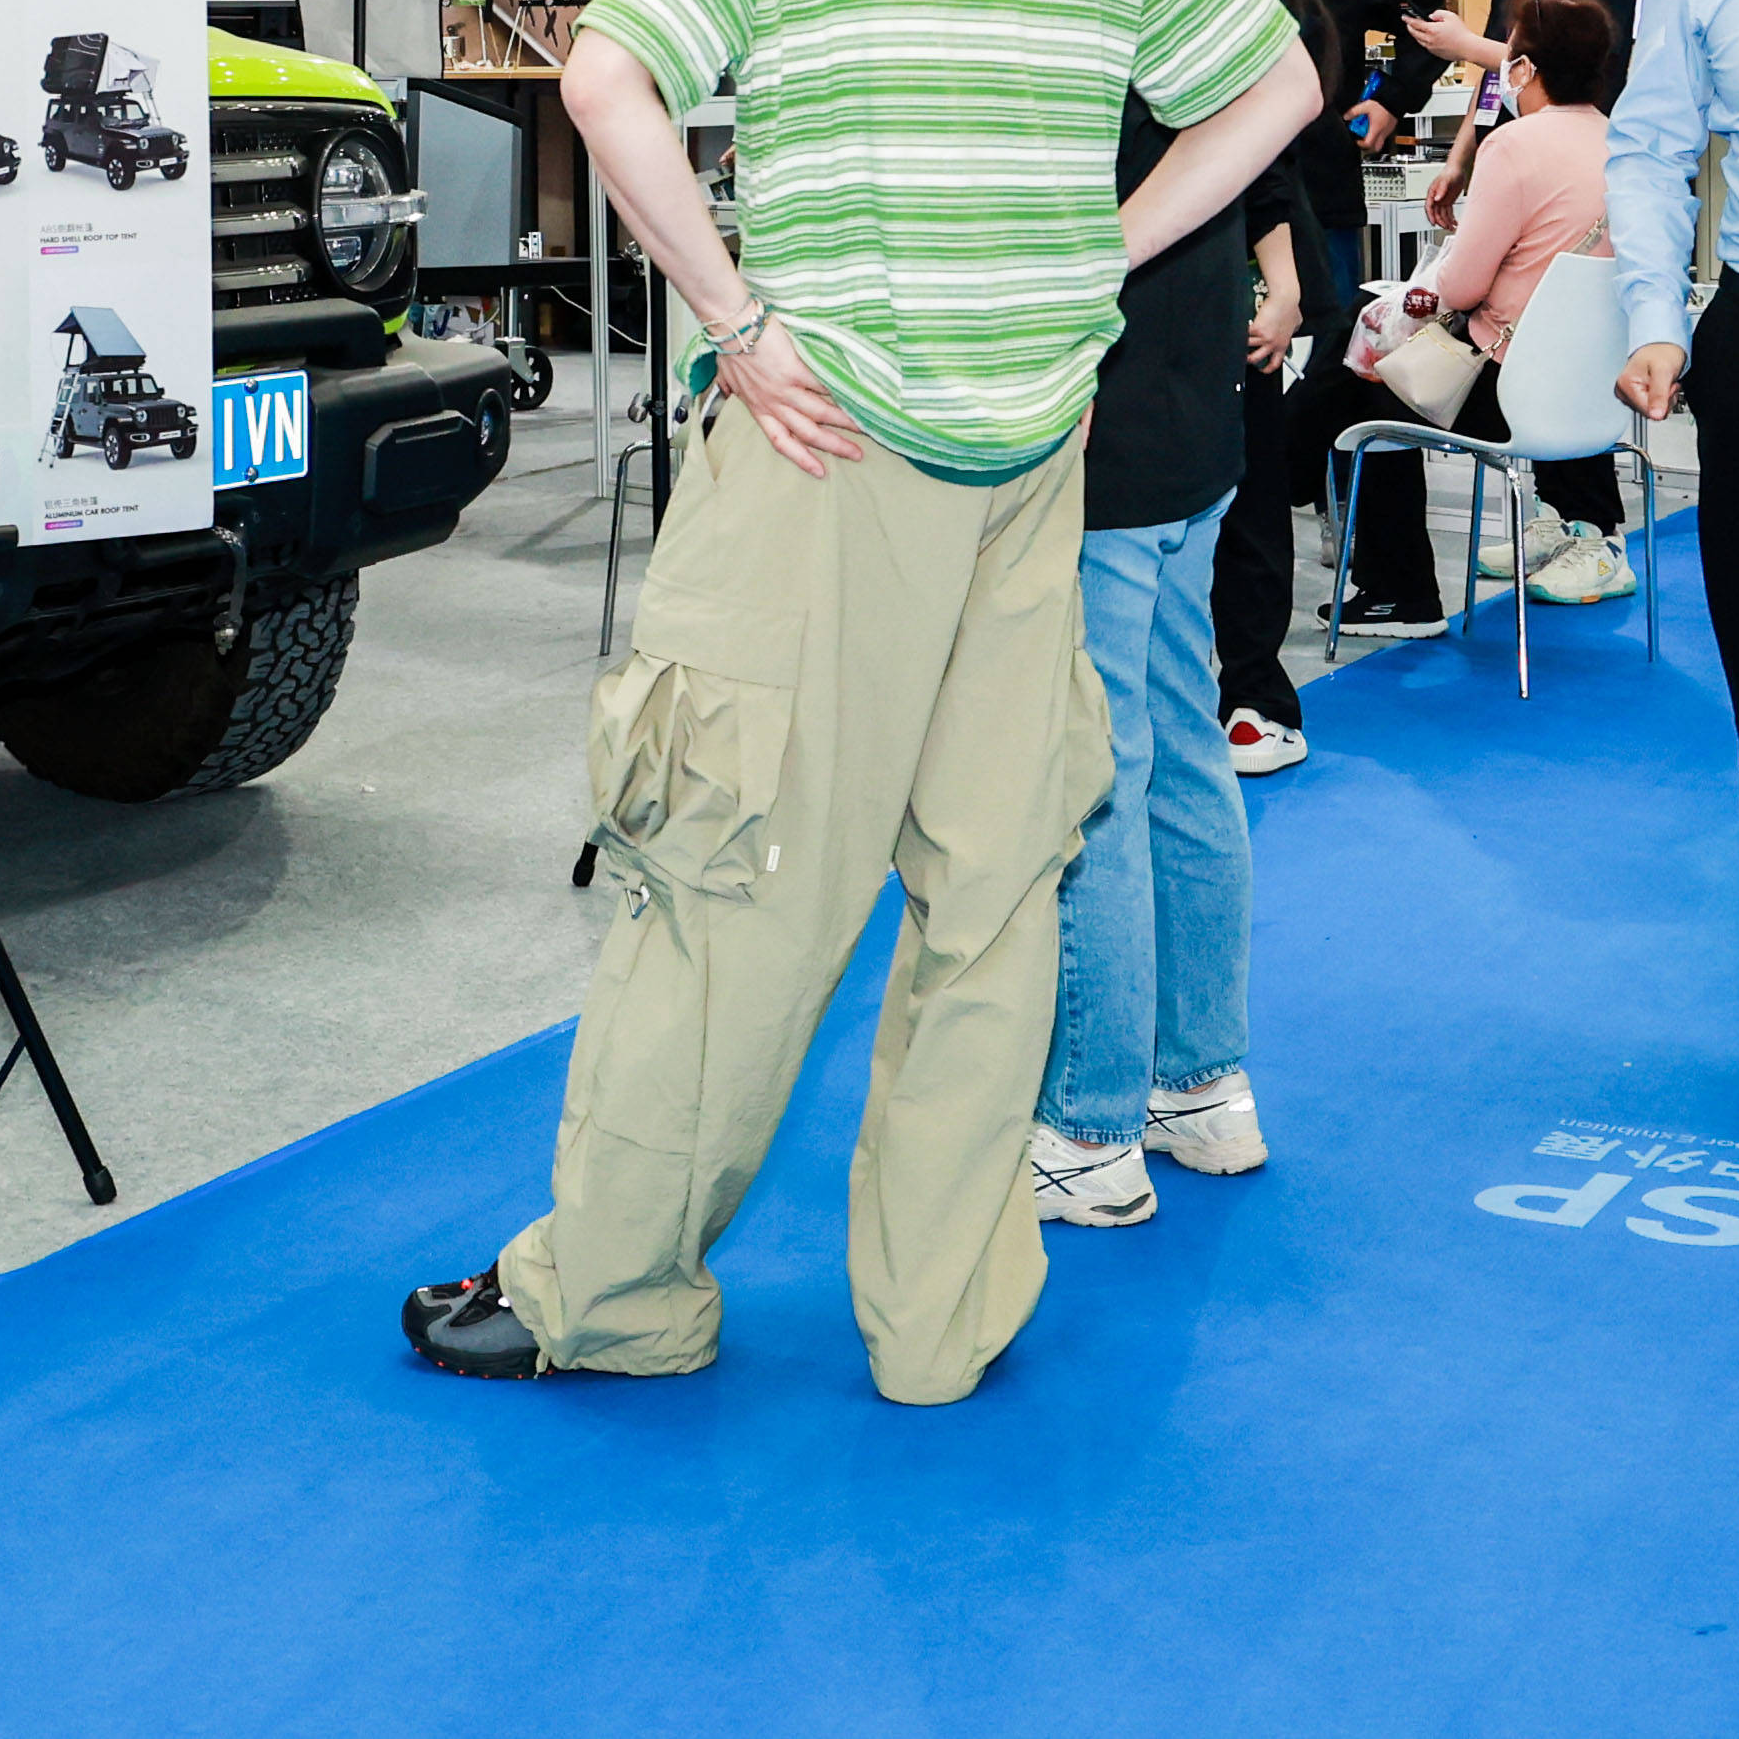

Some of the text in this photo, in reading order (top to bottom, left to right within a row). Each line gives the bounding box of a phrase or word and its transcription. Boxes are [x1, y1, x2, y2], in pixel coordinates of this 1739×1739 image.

[40, 232, 138, 244] HARD SHELL ROOF TOP TENT
[44, 510, 84, 519] ALUMINUM
[84, 508, 99, 516] CAR
[122, 504, 140, 513] TENT
[1558, 1117, 1698, 1144] Exhibition
